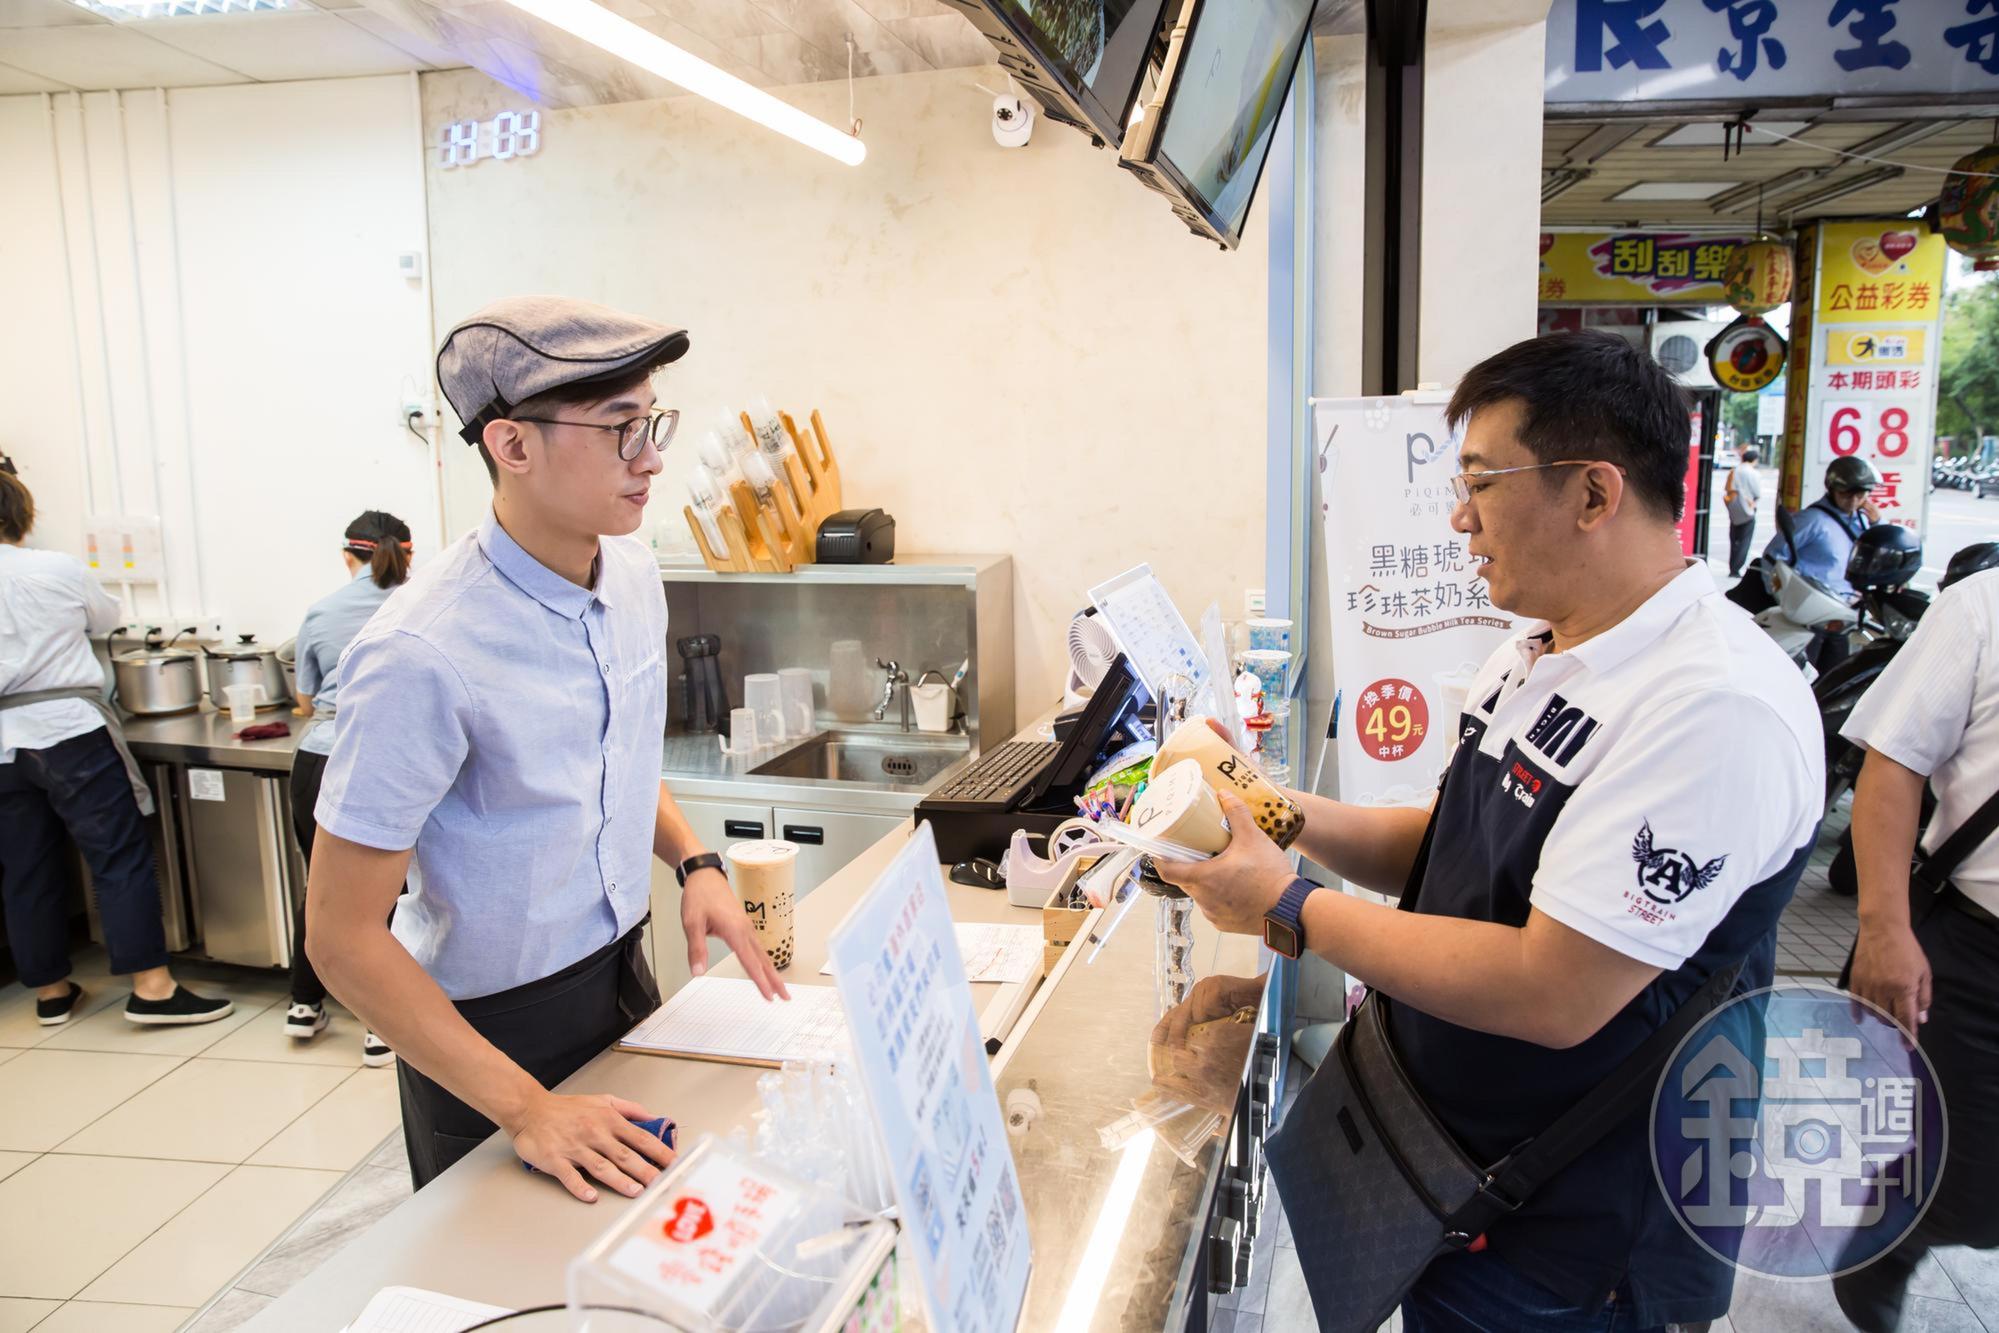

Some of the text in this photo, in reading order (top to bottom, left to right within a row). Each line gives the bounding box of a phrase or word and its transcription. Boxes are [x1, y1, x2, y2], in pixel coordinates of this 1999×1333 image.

[1829, 281, 1930, 311] 公益彩券
[1827, 370, 1921, 391] 本期頭彩
[1366, 616, 1504, 639] Brown Sugar Bubble Milk Tea Series
[1379, 744, 1404, 758] 中杯
[1645, 857, 1683, 896] A
[1623, 890, 1677, 921] BIGTRAIN
[1627, 905, 1665, 927] STREET
